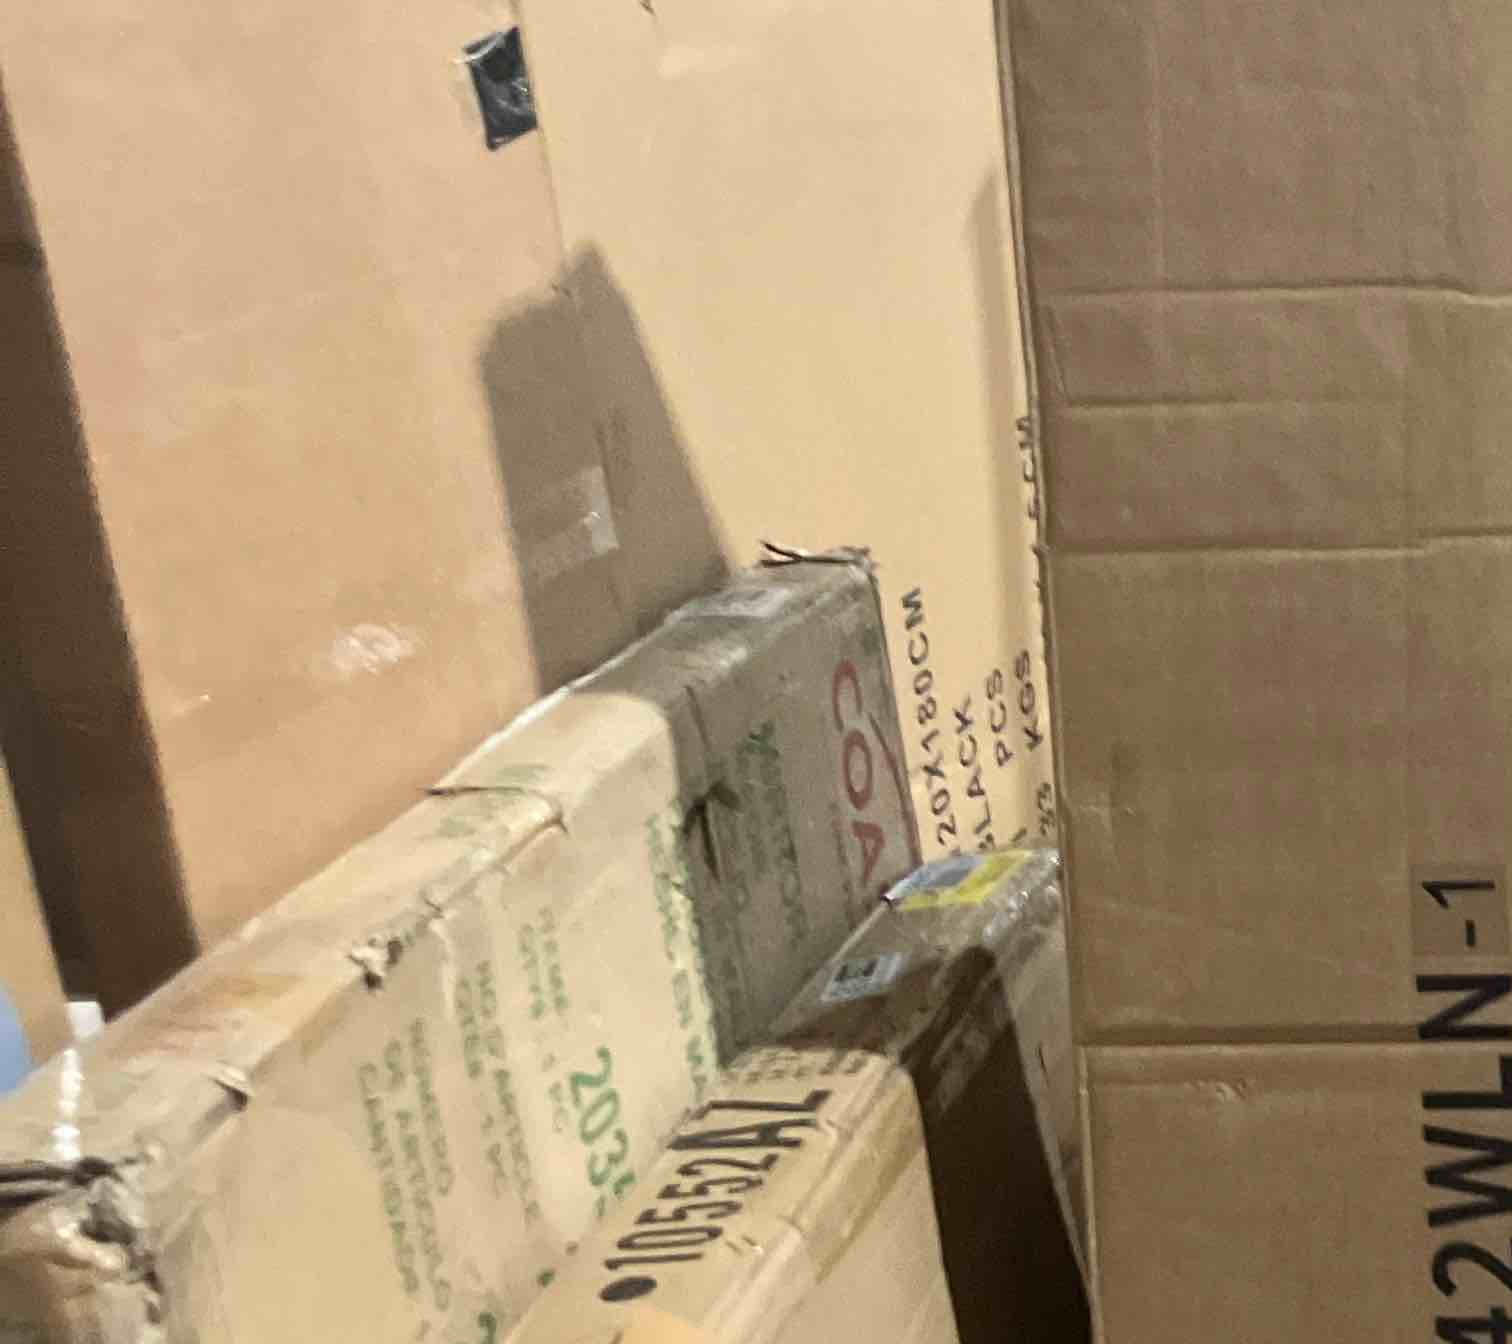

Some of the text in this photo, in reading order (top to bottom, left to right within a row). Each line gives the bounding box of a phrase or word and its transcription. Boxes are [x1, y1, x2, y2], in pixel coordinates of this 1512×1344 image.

[832, 658, 885, 886] COA
[901, 587, 960, 849] 20X180CM
[985, 667, 1014, 767] PCS
[1014, 650, 1044, 752] KGS
